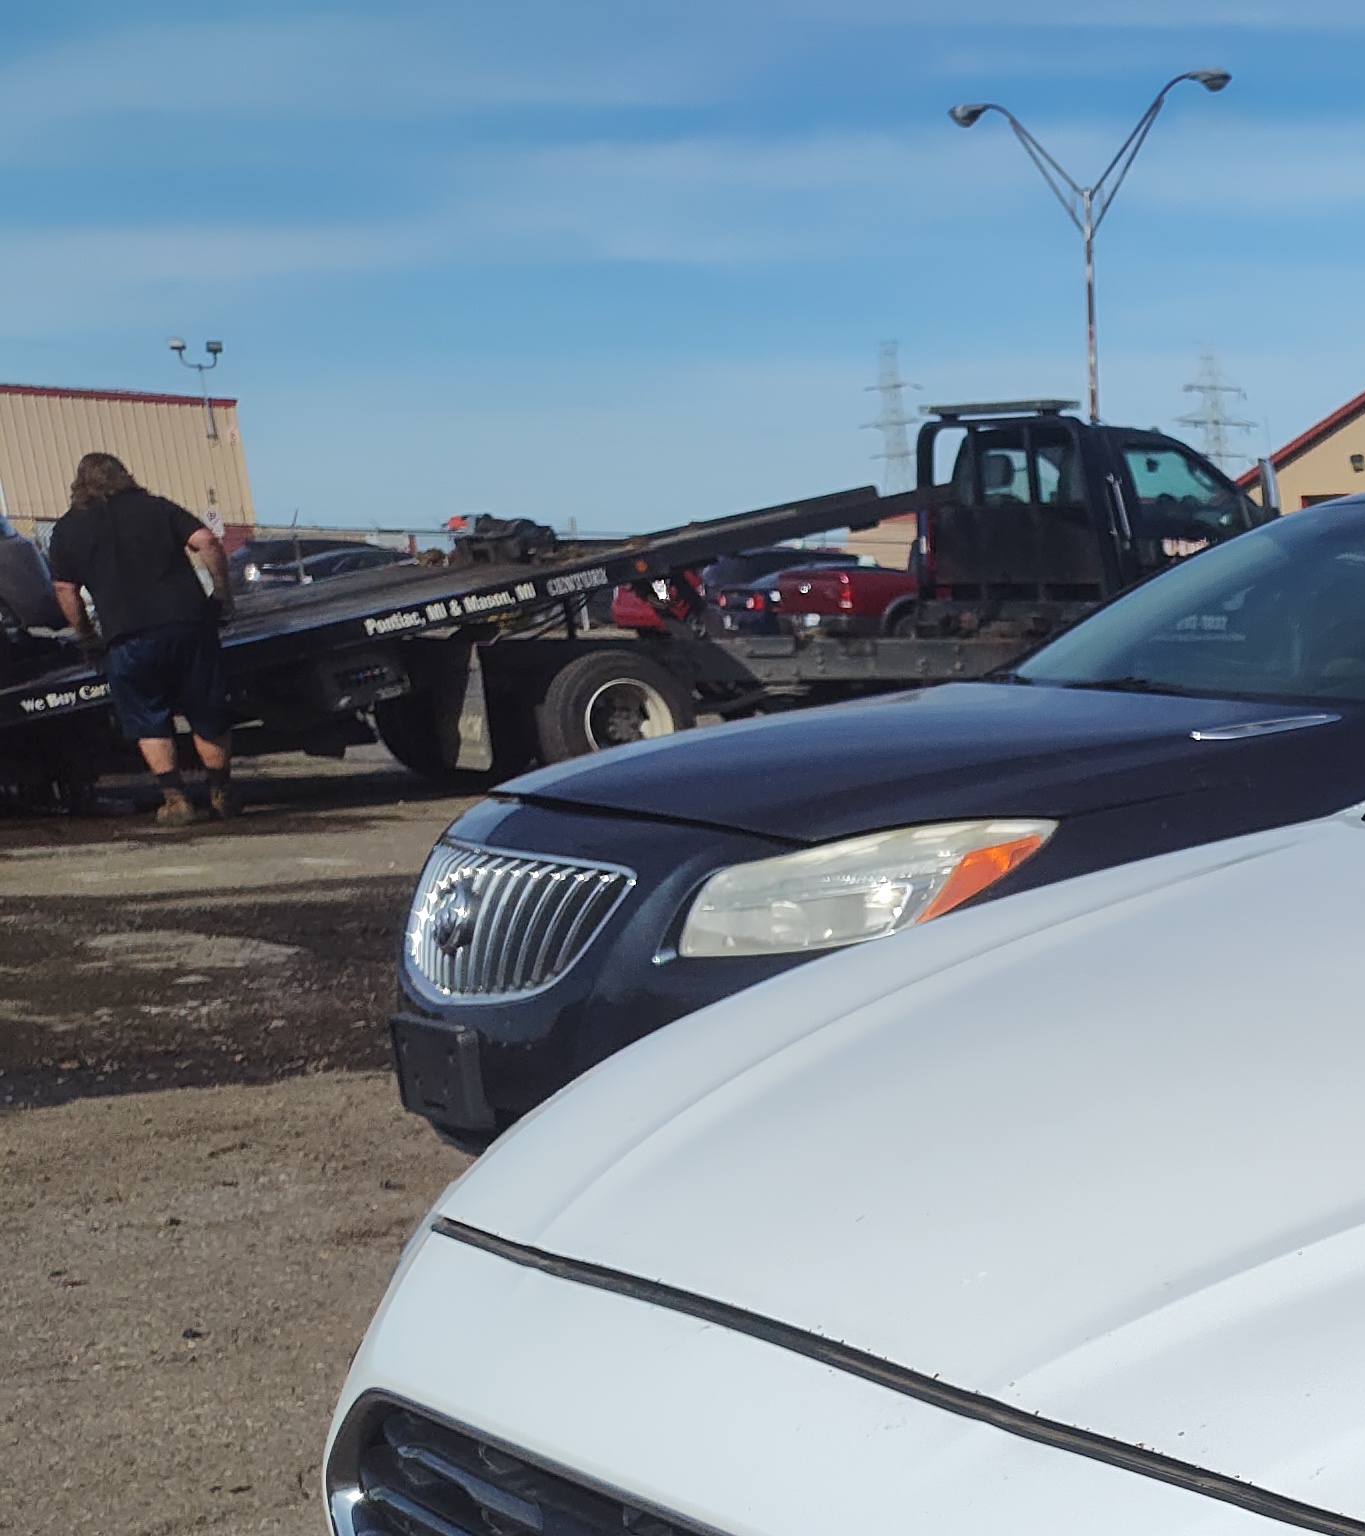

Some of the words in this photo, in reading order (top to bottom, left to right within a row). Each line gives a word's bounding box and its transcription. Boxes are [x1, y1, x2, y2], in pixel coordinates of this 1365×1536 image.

[364, 609, 427, 636] Pontiac,
[425, 602, 448, 622] MI
[449, 599, 462, 617] &
[464, 590, 516, 613] Mason,
[514, 582, 537, 601] MI
[20, 697, 46, 713] We
[45, 691, 77, 709] Buy
